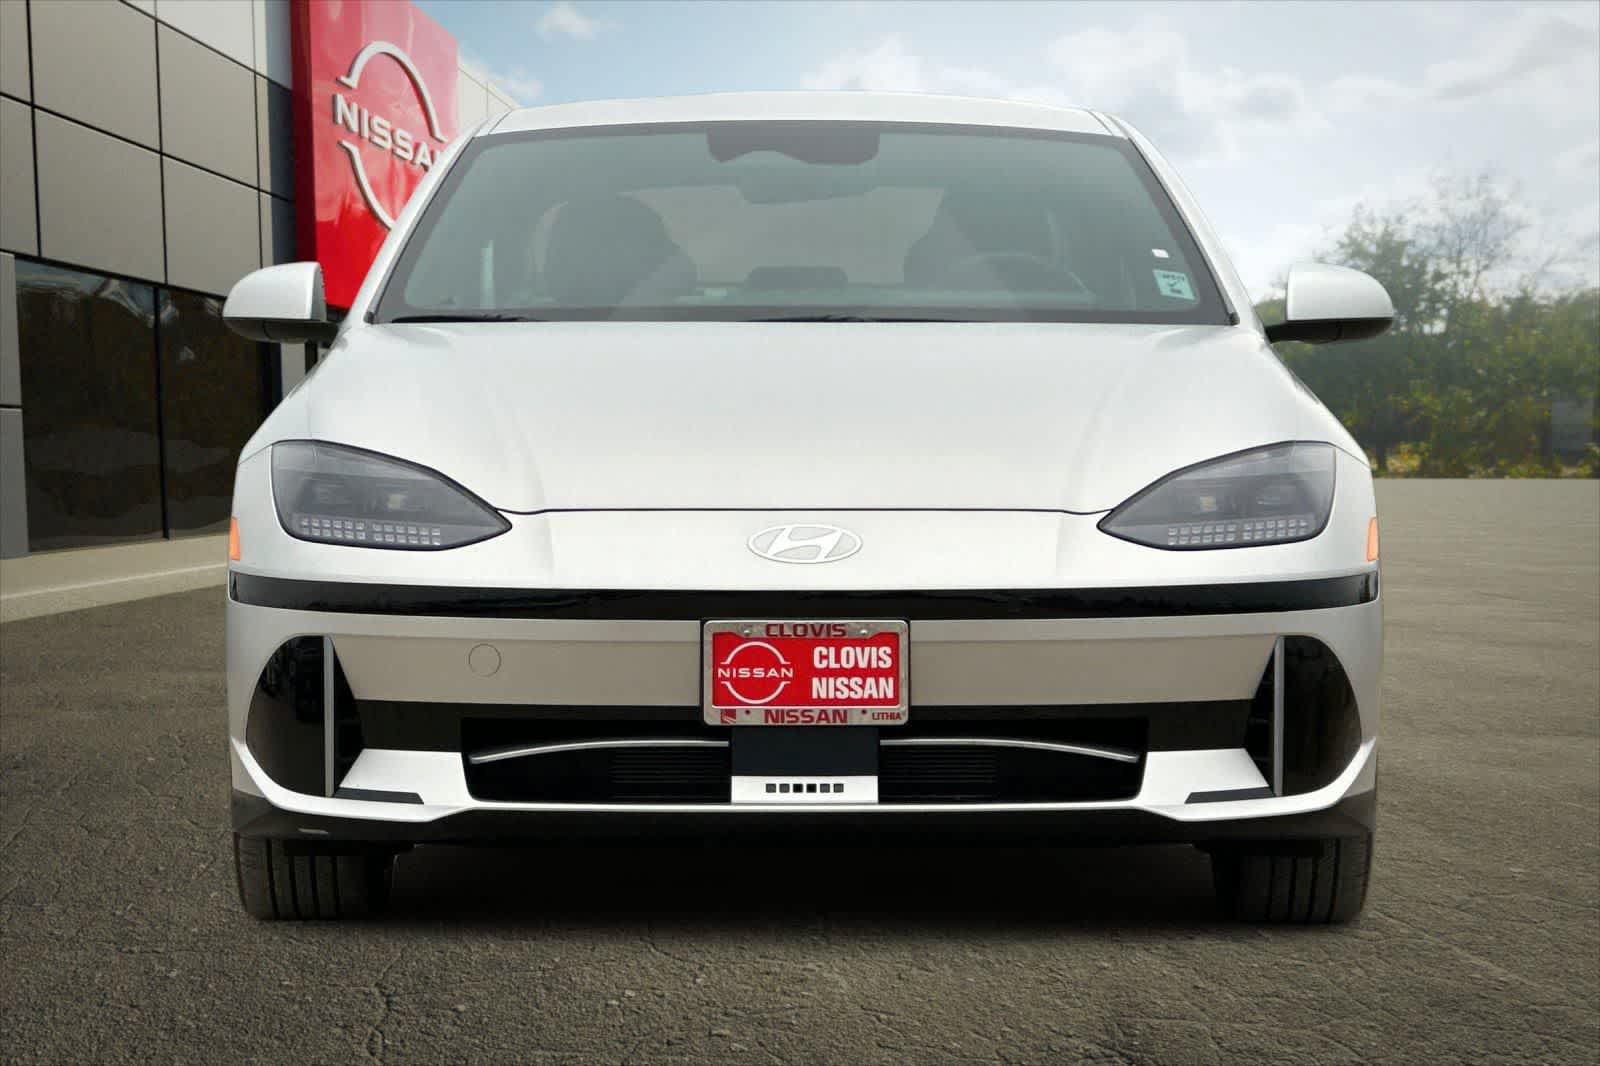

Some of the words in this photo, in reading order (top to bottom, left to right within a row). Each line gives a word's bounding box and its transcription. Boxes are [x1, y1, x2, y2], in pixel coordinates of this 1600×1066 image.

[333, 93, 441, 172] NISSA
[766, 624, 847, 637] CLOVIS
[813, 646, 893, 669] CLOVIS
[718, 667, 794, 678] NISSAN
[812, 677, 894, 699] NISSAN
[764, 709, 848, 724] NISSAN
[872, 712, 901, 720] LITHIA
